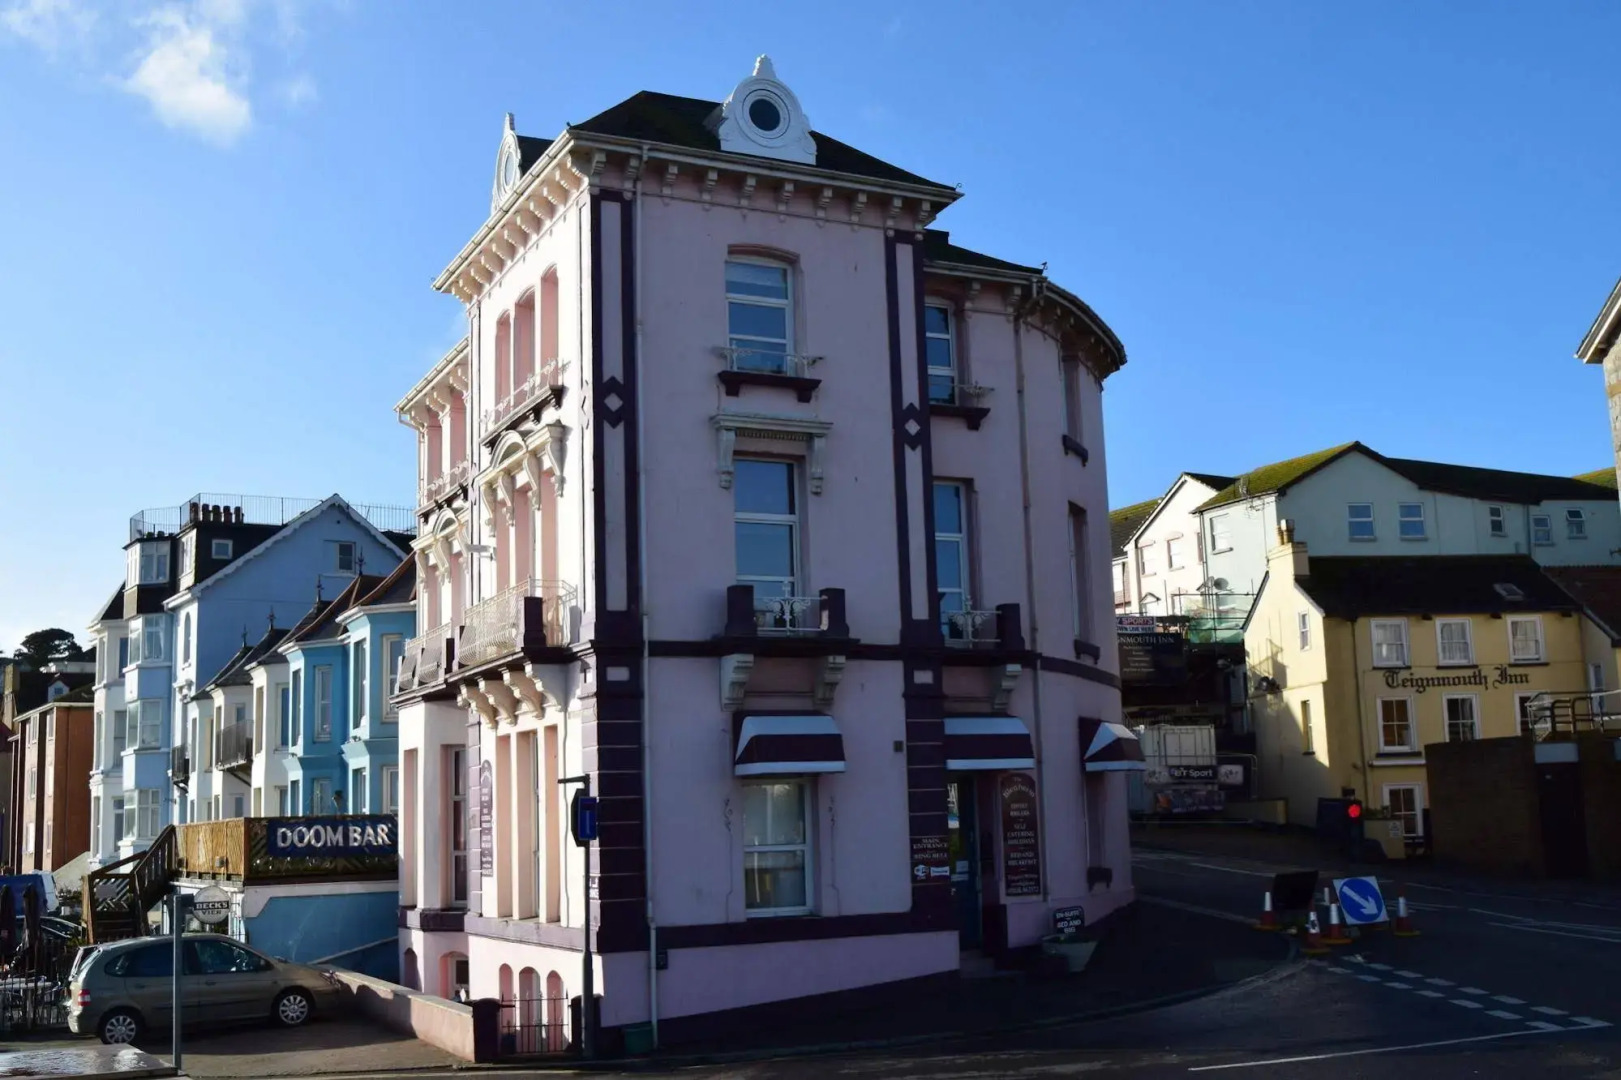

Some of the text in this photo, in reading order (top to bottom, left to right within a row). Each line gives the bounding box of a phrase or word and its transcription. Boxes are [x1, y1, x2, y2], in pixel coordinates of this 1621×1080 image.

[1122, 617, 1153, 625] SPORTS
[1158, 635, 1176, 645] INN
[1383, 664, 1530, 694] Teignmouth Inn
[1188, 769, 1213, 778] Sport
[277, 824, 392, 848] DOOM BAR
